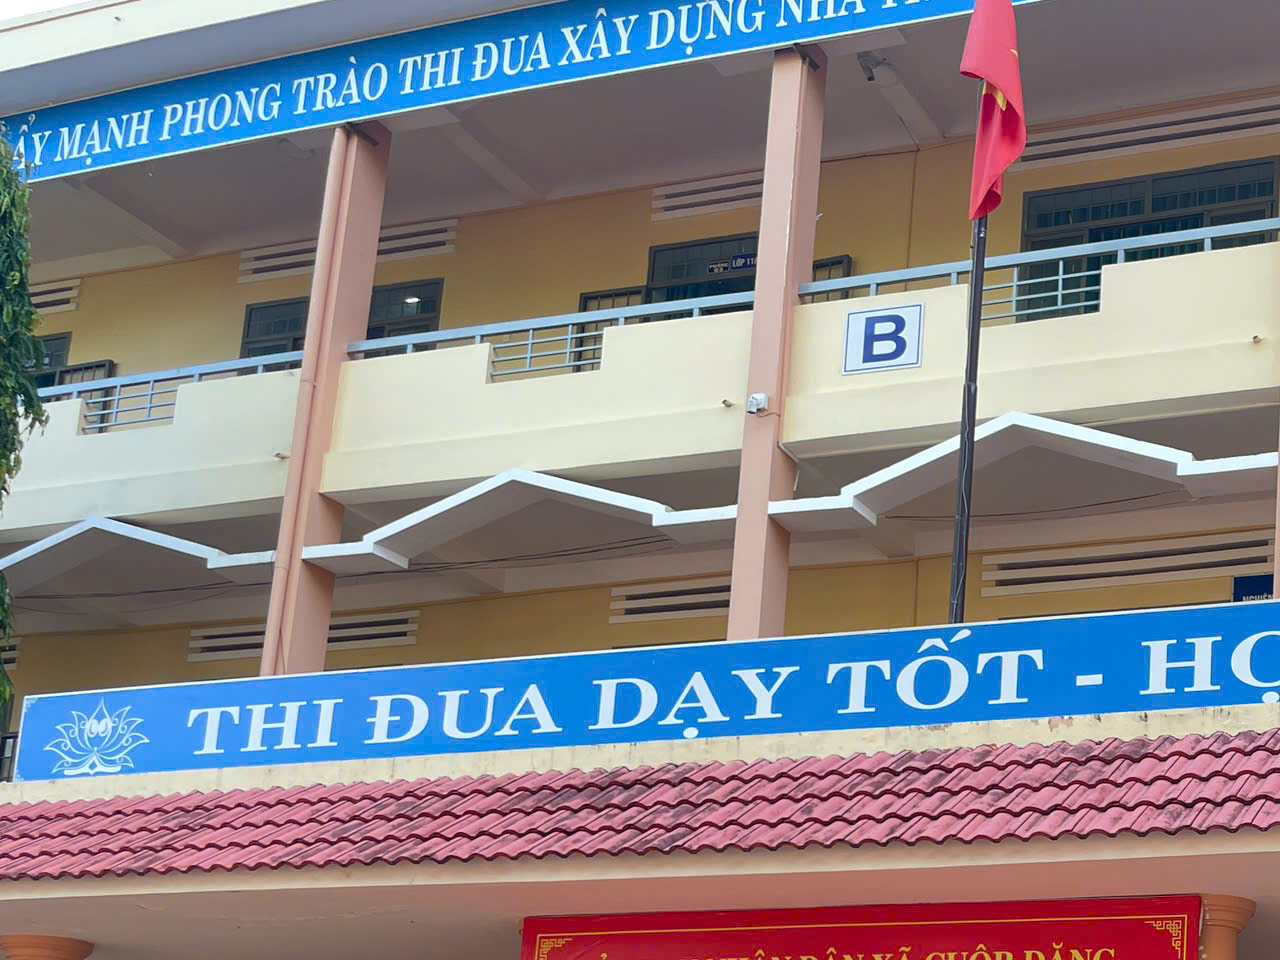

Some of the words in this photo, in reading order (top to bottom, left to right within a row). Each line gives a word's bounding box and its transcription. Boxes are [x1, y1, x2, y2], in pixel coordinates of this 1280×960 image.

[12, 113, 52, 169] ẨY
[53, 110, 154, 165] MẠNH
[159, 82, 282, 141] PHONG
[292, 56, 388, 115] TRÀO
[399, 47, 464, 95] THI
[471, 31, 551, 82] ĐUA
[557, 7, 640, 66] XÂY
[646, 0, 767, 55] DỤNG
[862, 314, 907, 364] B
[187, 698, 343, 756] THI
[364, 683, 562, 746] ĐUA
[588, 666, 799, 739] DẠY
[826, 629, 1044, 715] TỐT
